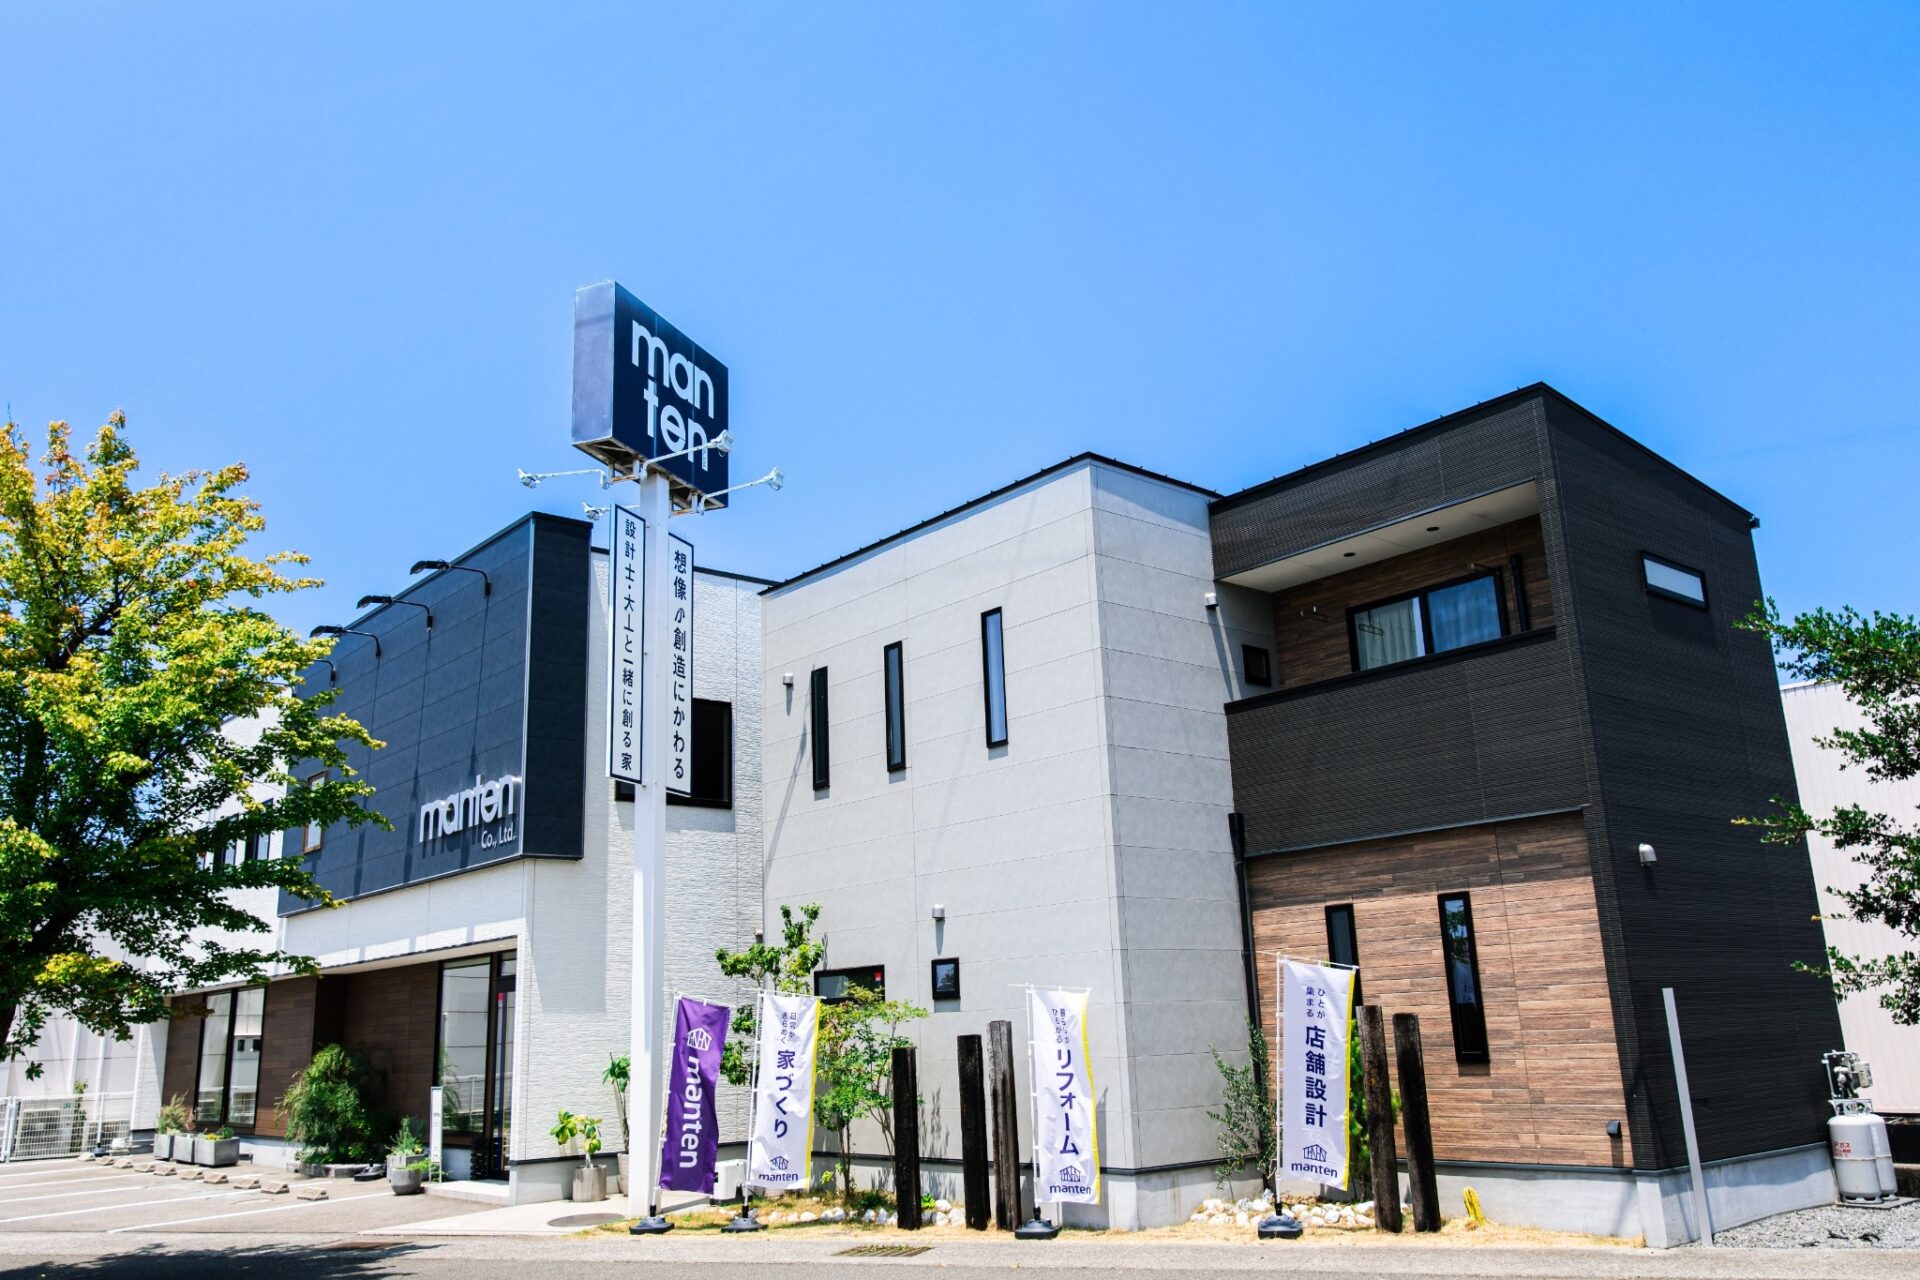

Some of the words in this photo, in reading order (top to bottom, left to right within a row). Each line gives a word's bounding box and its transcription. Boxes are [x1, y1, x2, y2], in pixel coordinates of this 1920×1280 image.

[632, 319, 715, 419] man
[643, 378, 708, 472] ten
[419, 774, 516, 843] manten
[1305, 986, 1315, 1018] 集まる
[1316, 987, 1327, 1019] ひとが
[679, 1055, 703, 1168] manten
[774, 1049, 796, 1139] 家づくり
[1056, 1049, 1080, 1156] リフォーム
[1305, 1025, 1328, 1128] 店舗設計
[758, 1172, 799, 1182] manten
[1049, 1184, 1091, 1195] manten
[1291, 1162, 1338, 1179] manten
